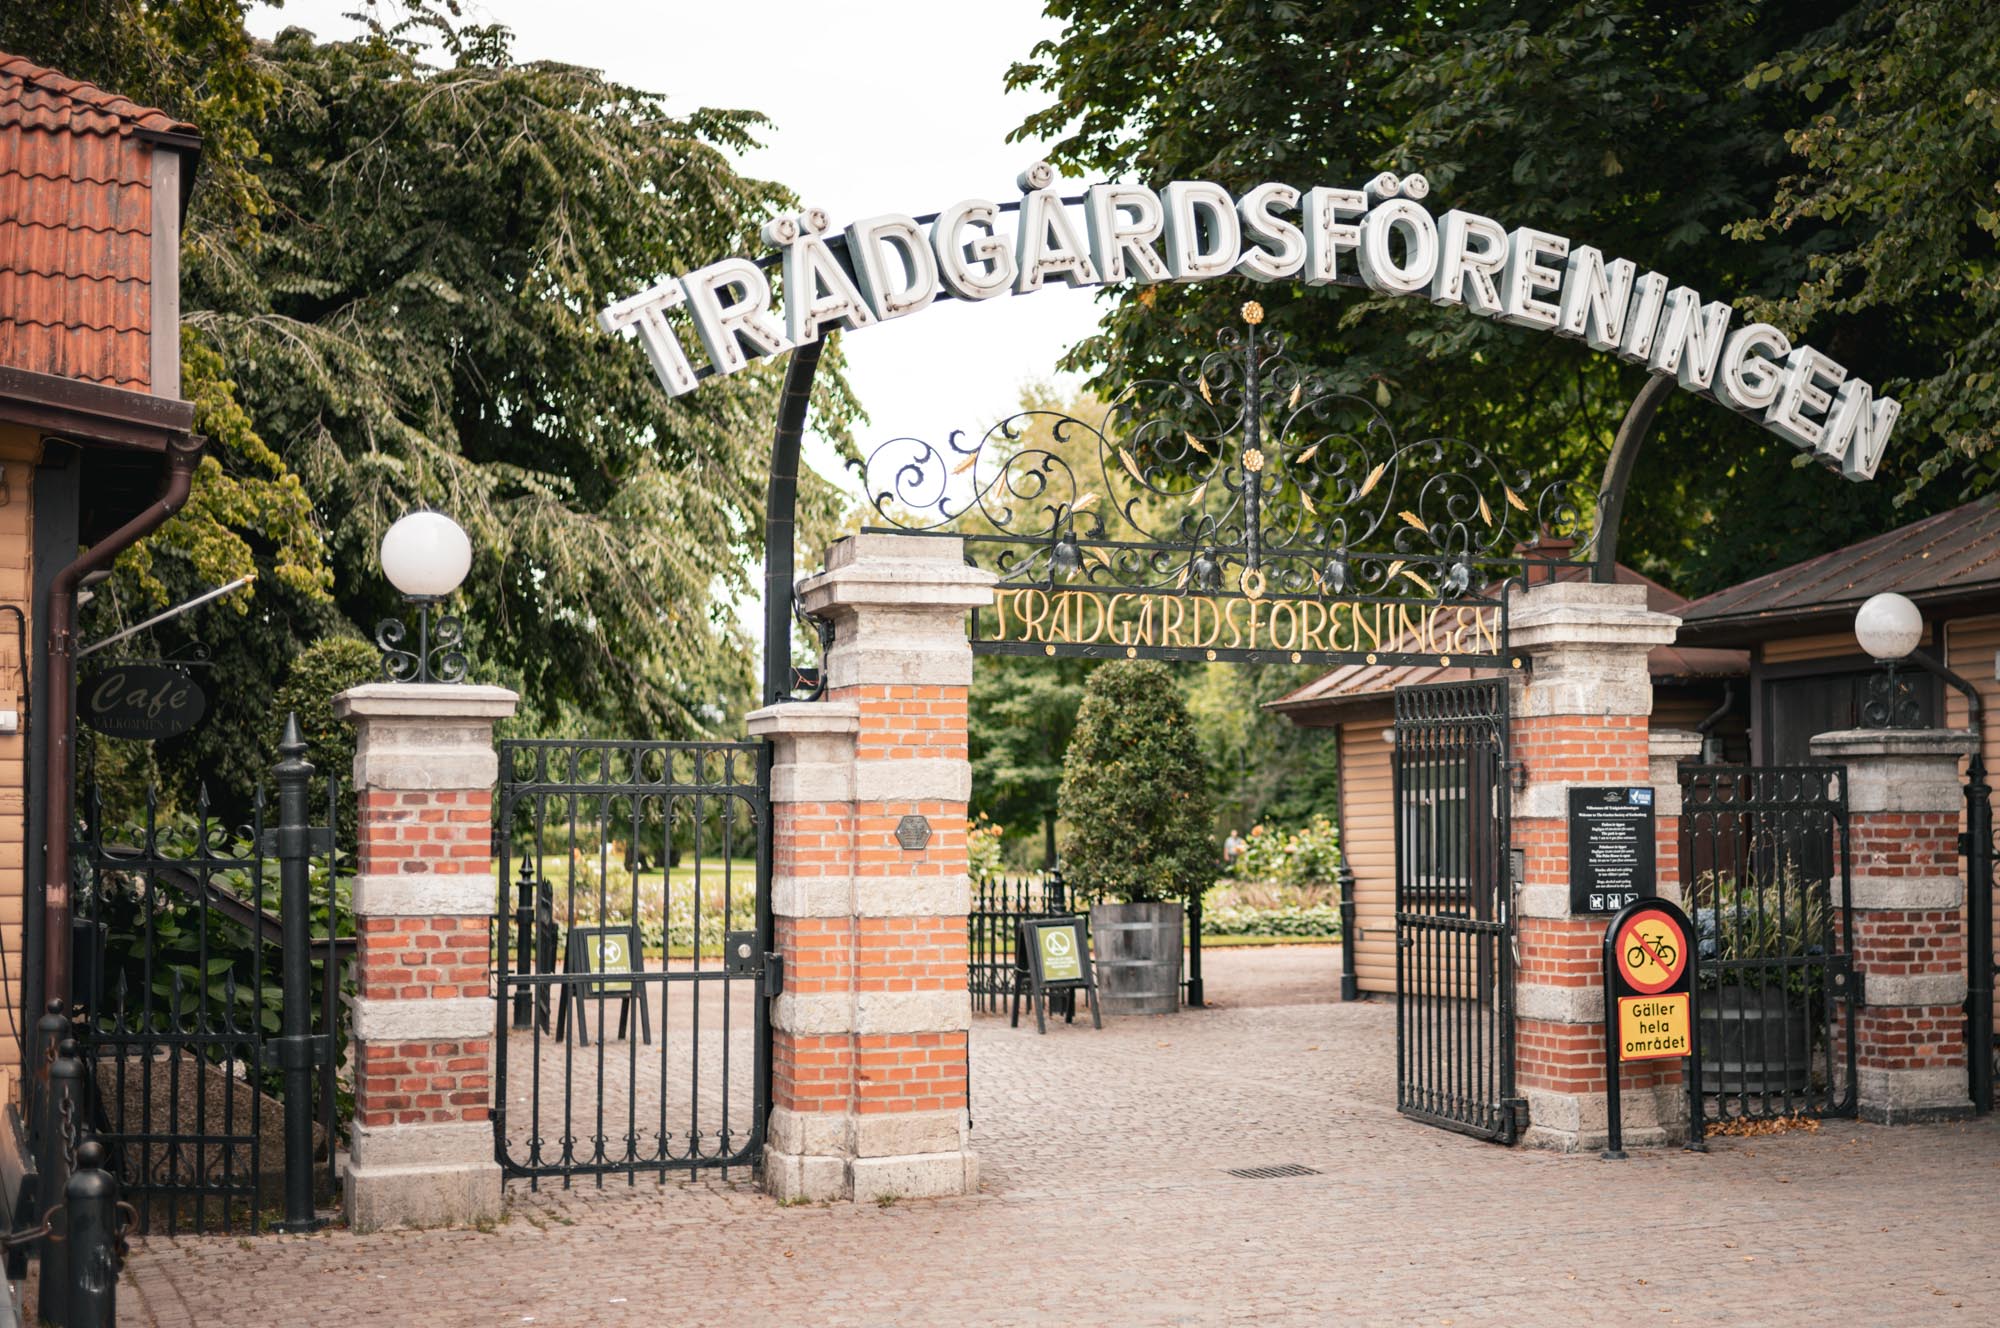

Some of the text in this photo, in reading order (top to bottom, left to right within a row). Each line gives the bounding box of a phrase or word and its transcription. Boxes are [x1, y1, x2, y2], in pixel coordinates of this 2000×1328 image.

[600, 161, 1902, 482] TRÄDGÅRDSFÖRENINGEN
[91, 673, 191, 719] Café
[1632, 1003, 1675, 1017] Gäller
[1639, 1020, 1669, 1034] hela
[1626, 1036, 1685, 1052] området
